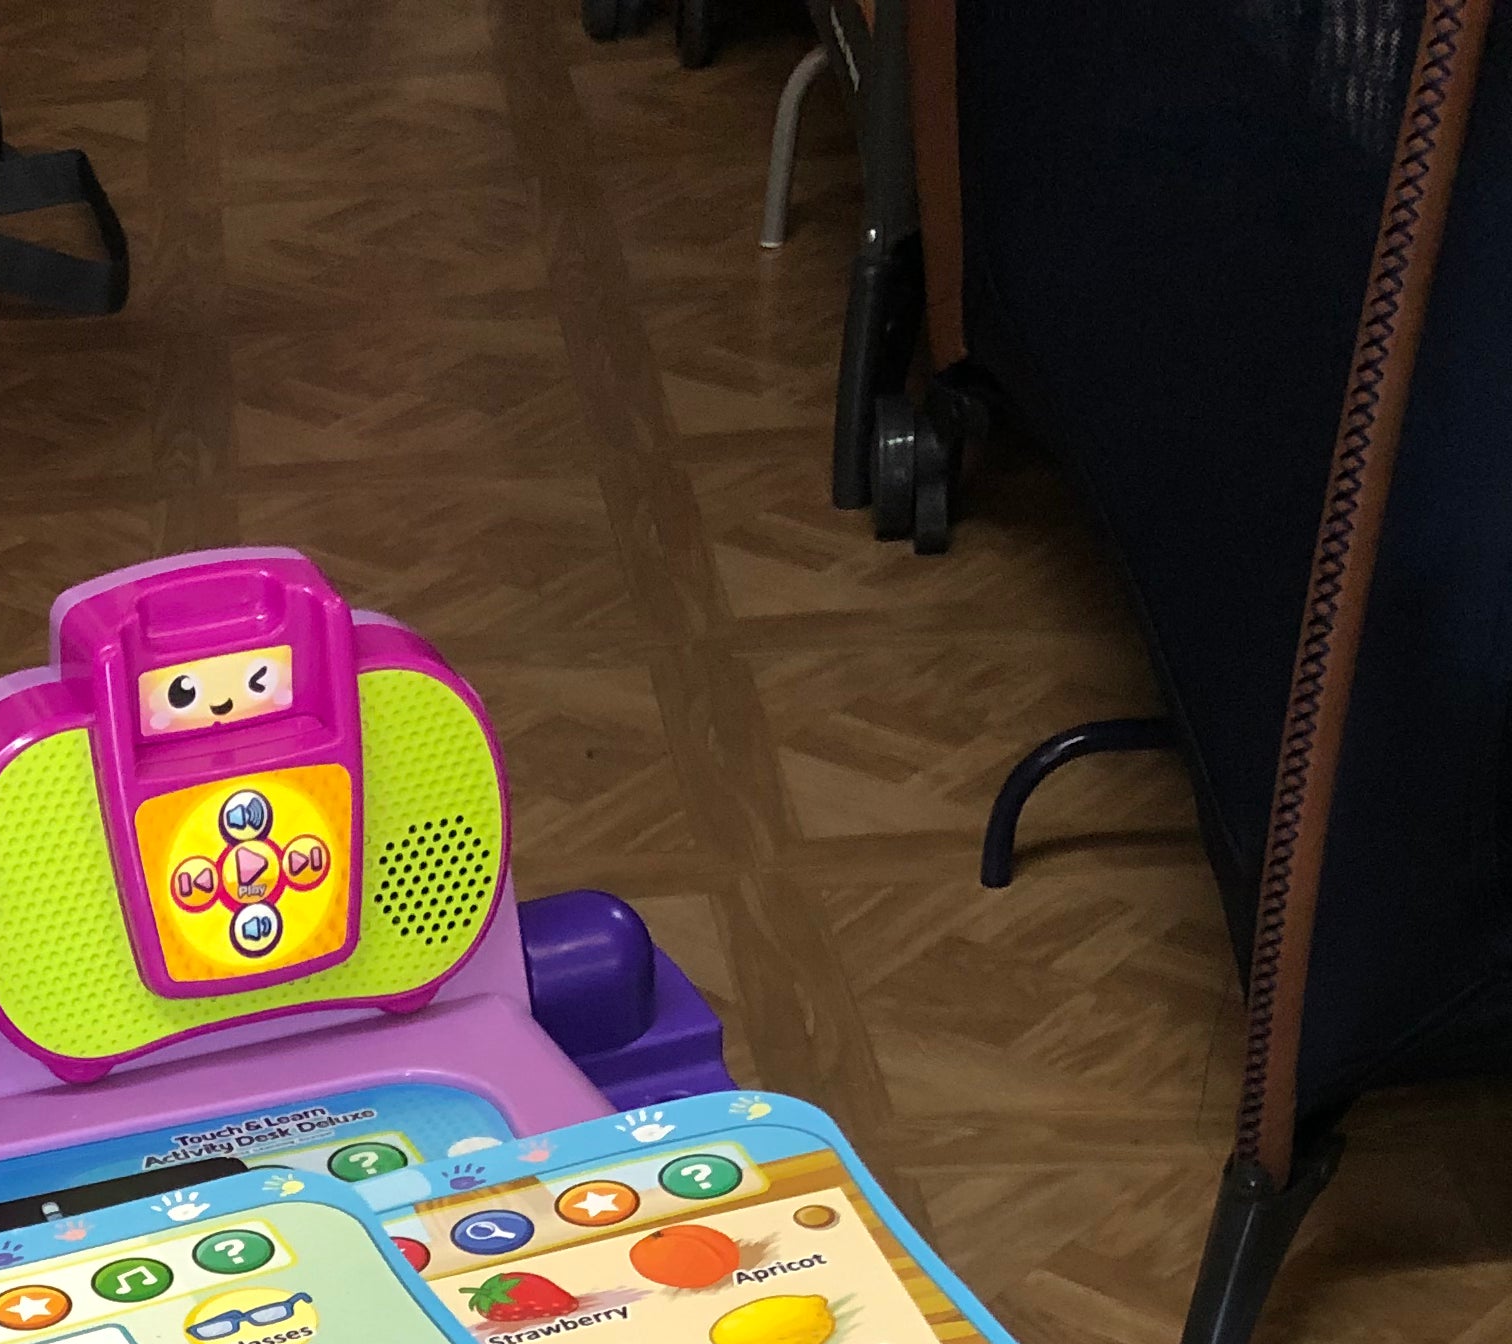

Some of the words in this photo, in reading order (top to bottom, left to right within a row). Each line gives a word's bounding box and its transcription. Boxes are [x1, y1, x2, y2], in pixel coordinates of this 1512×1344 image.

[144, 1140, 234, 1169] Activity
[235, 1127, 291, 1149] Desk
[297, 1109, 376, 1132] Deluxe
[175, 1125, 243, 1147] Touch
[245, 1118, 263, 1133] &
[265, 1107, 326, 1129] Learn
[735, 1253, 829, 1285] Apricot
